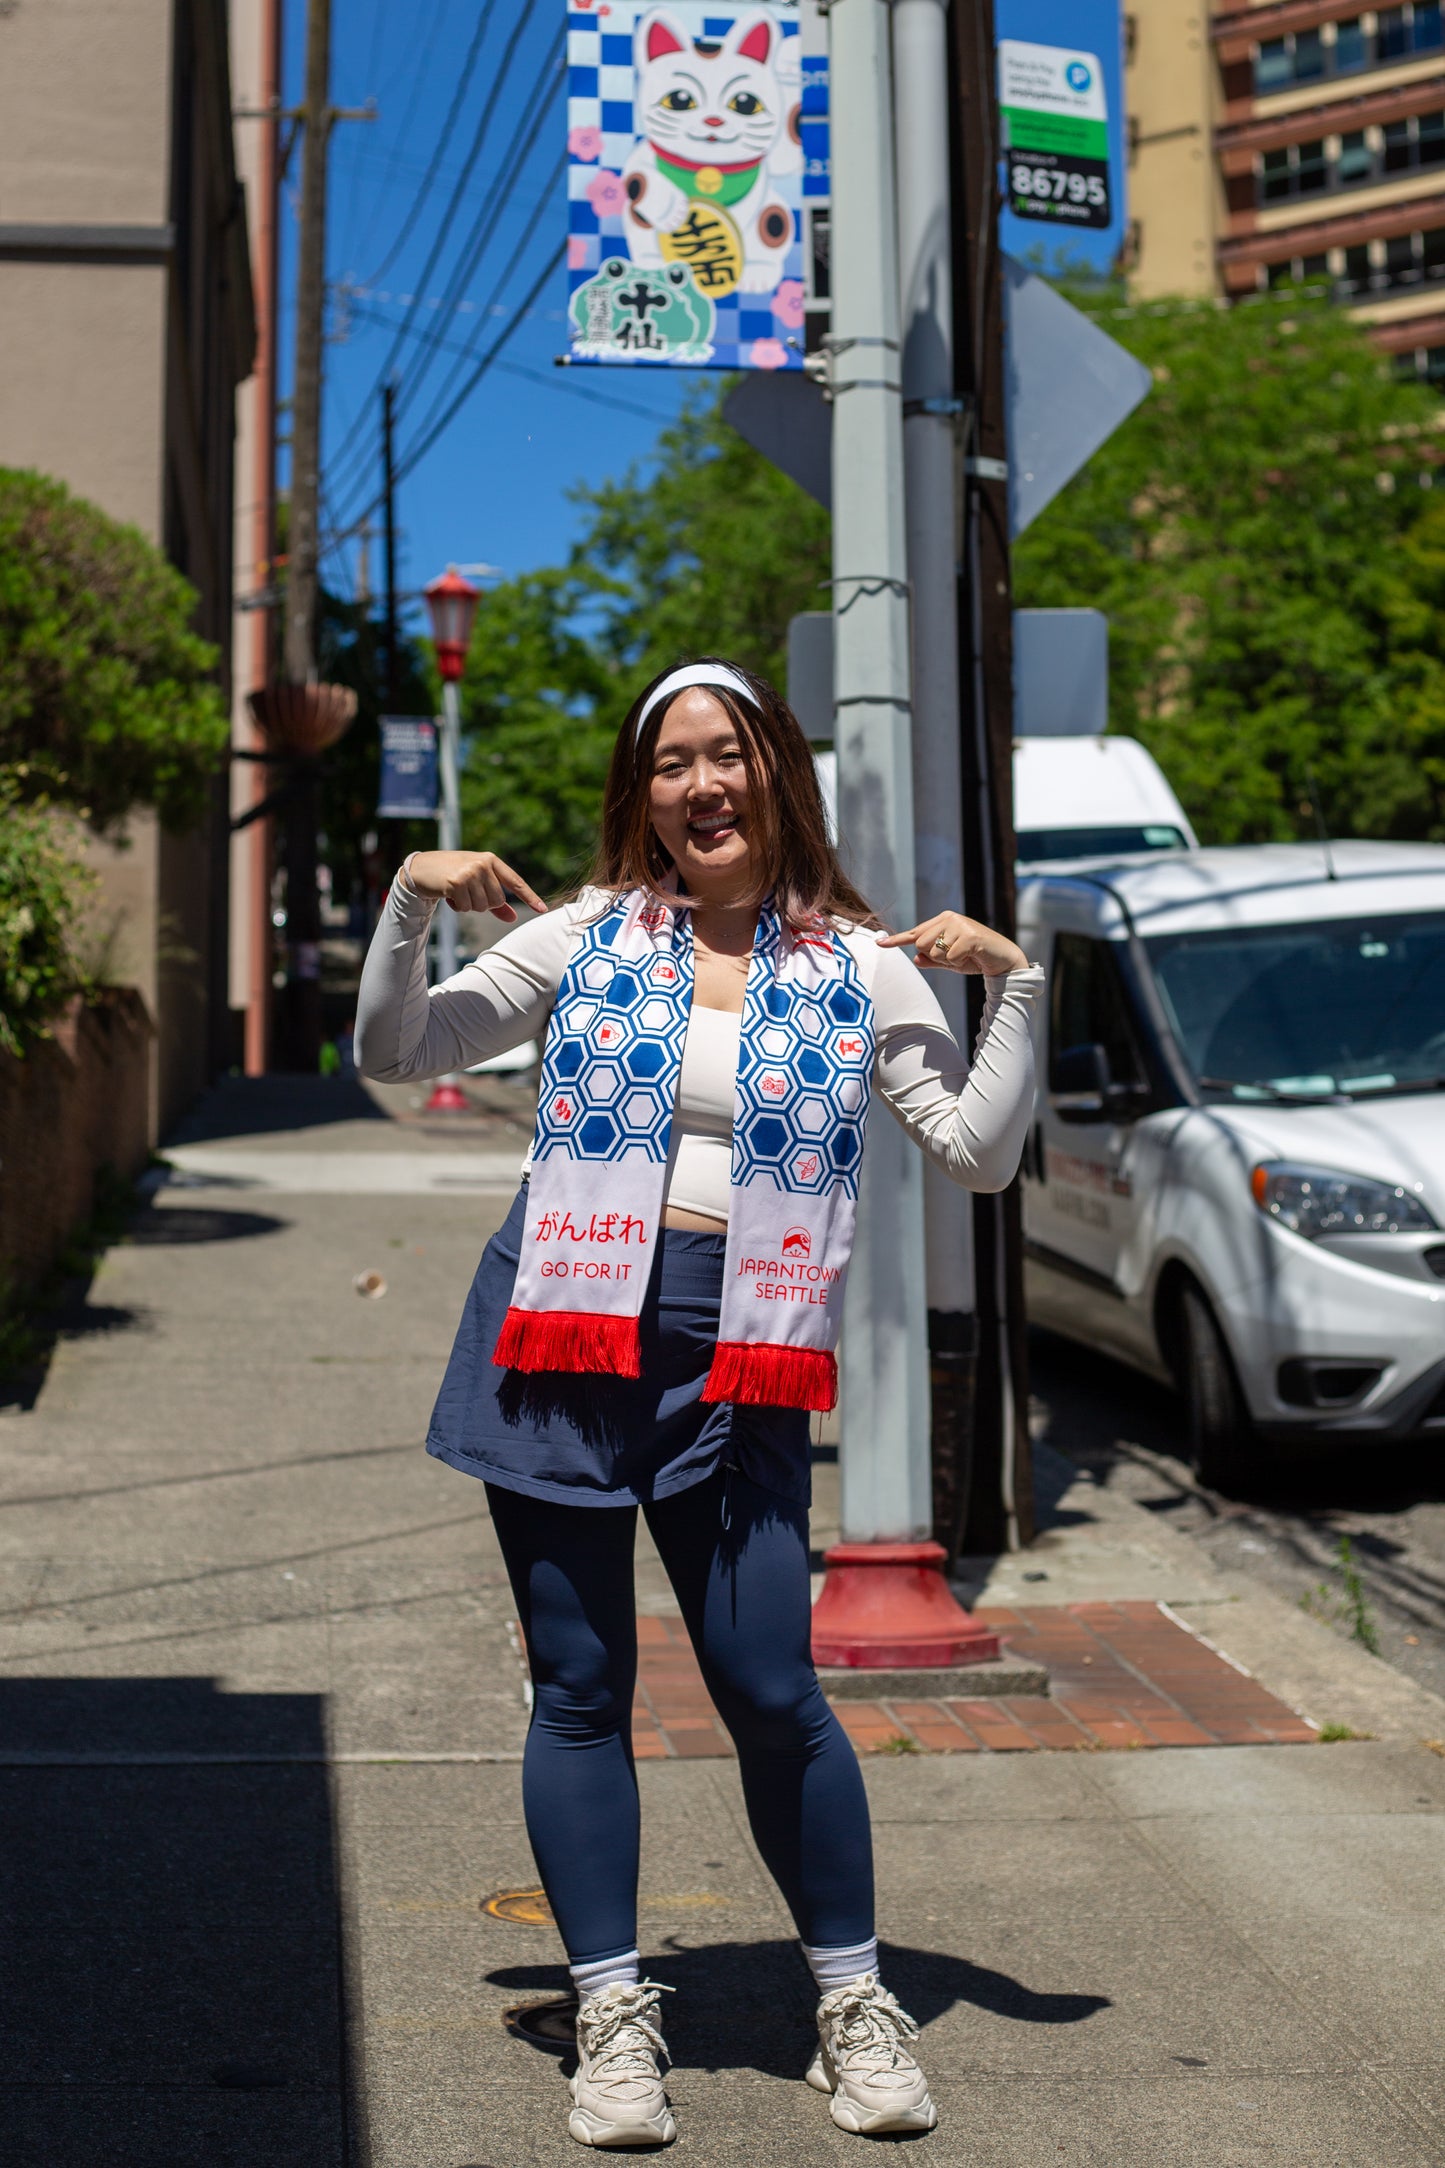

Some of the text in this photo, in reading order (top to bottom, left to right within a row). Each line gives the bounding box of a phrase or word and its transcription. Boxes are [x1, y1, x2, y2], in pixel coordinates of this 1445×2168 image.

[1011, 164, 1107, 206] 86795
[535, 1210, 648, 1245] がんばれ
[540, 1261, 633, 1281] GO FOR IT
[737, 1257, 843, 1285] JAPANTOWN
[755, 1282, 829, 1305] SEATTLE
